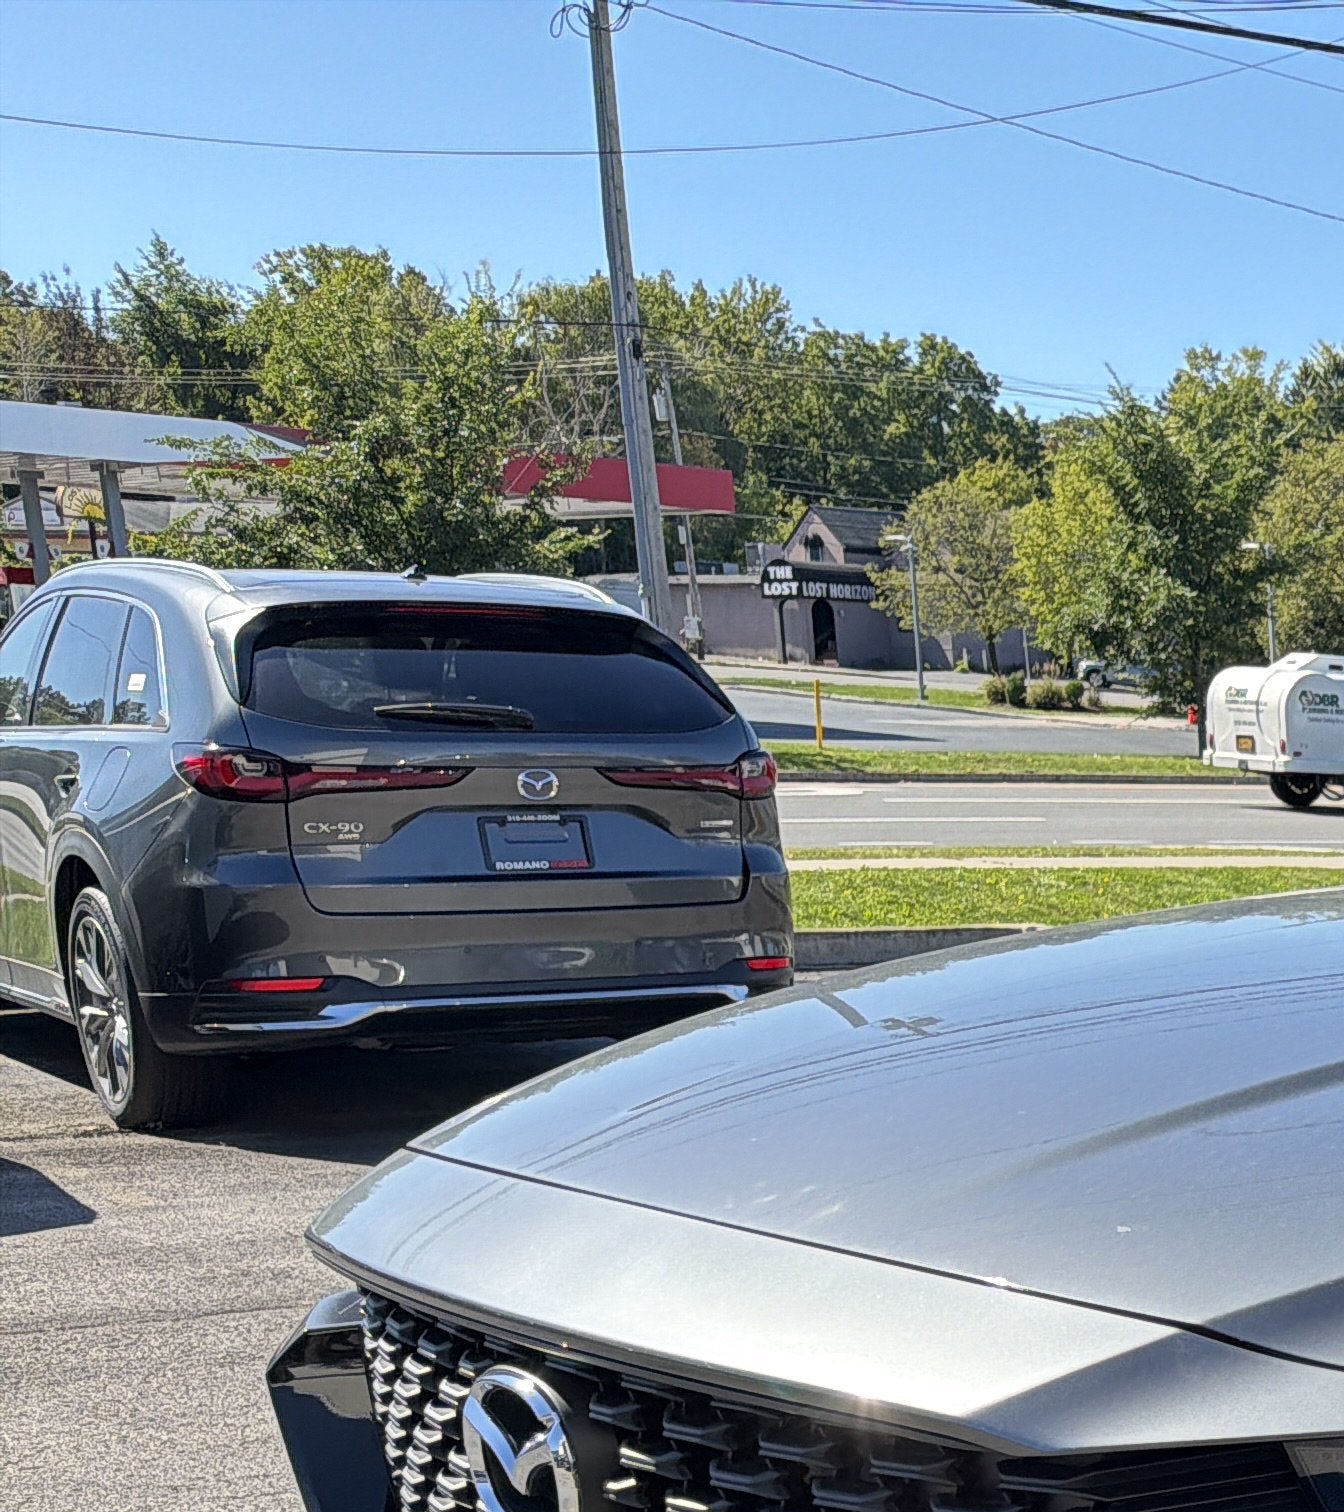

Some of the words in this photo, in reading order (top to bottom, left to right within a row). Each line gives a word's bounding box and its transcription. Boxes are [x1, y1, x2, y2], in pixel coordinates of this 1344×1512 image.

[767, 565, 793, 580] THE
[763, 582, 799, 596] LOST
[802, 581, 827, 598] LOST
[829, 582, 876, 600] HORIZON
[1314, 693, 1340, 708] DBR
[303, 822, 364, 834] CX-90
[495, 861, 549, 870] ROMANO
